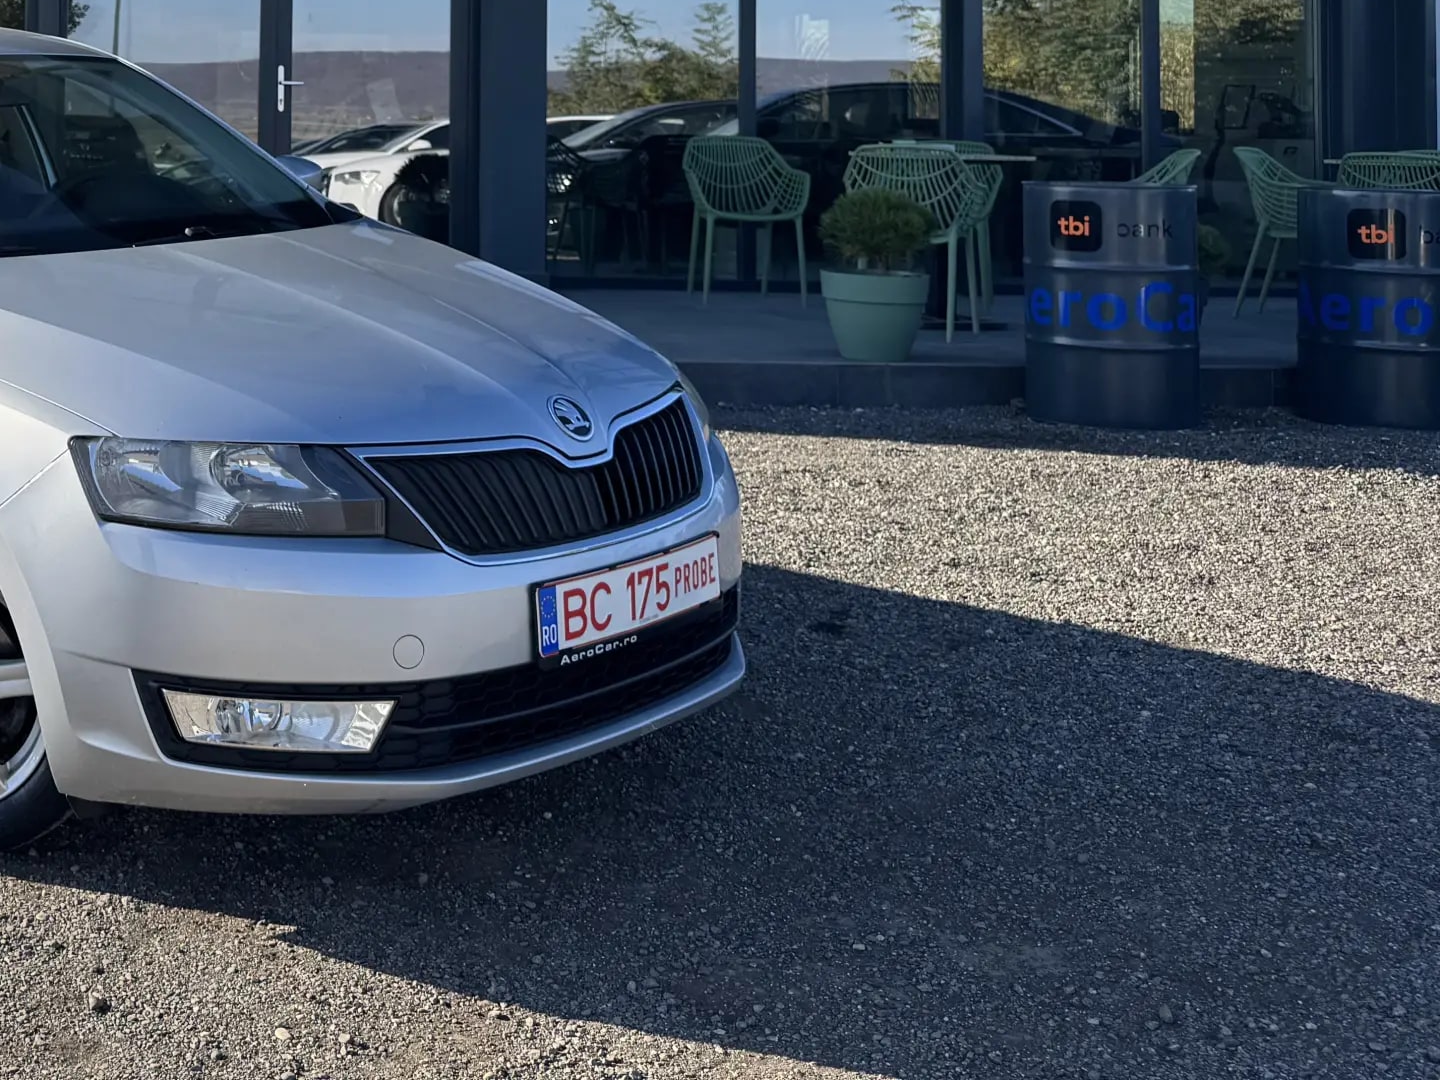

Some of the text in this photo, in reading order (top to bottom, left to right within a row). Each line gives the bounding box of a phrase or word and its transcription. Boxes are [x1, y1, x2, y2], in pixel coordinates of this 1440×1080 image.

[1057, 215, 1090, 237] tbi
[1357, 224, 1395, 244] tbi
[563, 552, 716, 641] BC 175 PROBE
[542, 623, 558, 647] RO
[560, 635, 638, 666] AeroCar.ro
